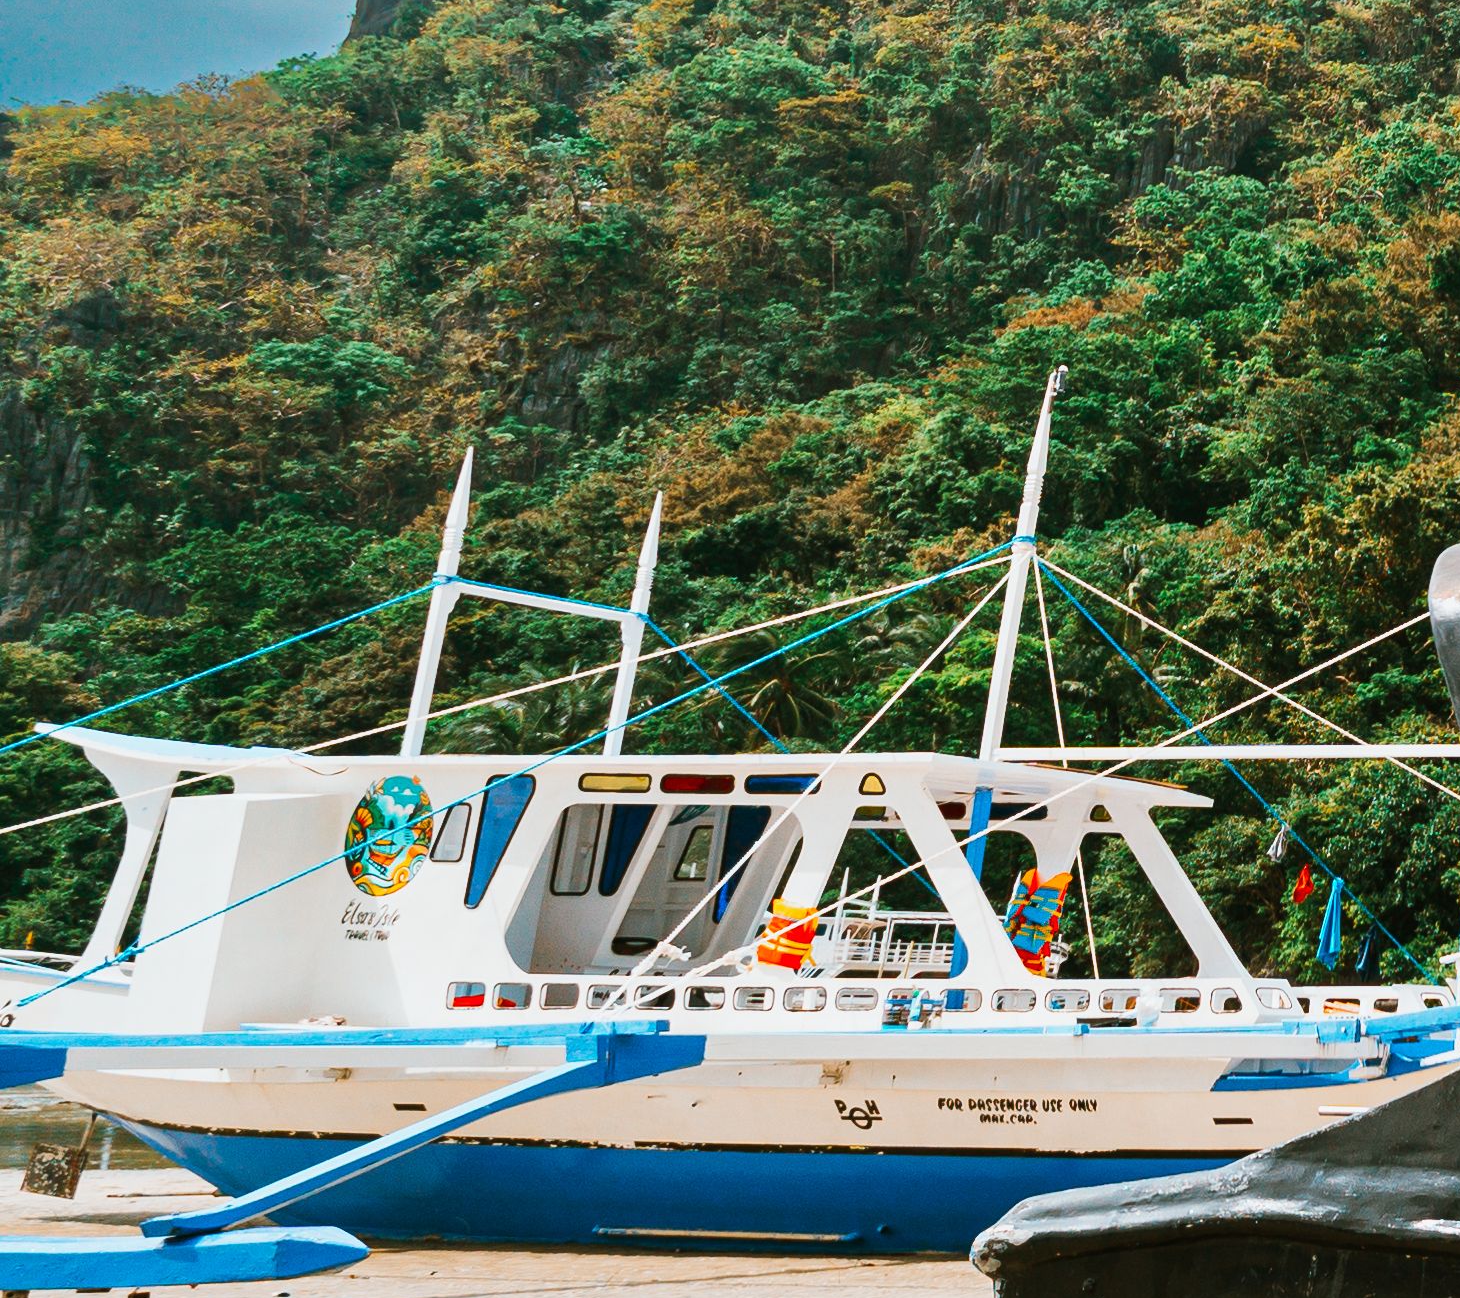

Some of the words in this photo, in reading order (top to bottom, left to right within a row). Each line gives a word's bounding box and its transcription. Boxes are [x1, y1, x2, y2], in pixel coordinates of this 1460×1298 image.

[937, 1097, 964, 1112] FOR
[967, 1098, 1039, 1113] PASSENGER
[1041, 1098, 1063, 1113] USE
[1068, 1098, 1098, 1112] ONLY
